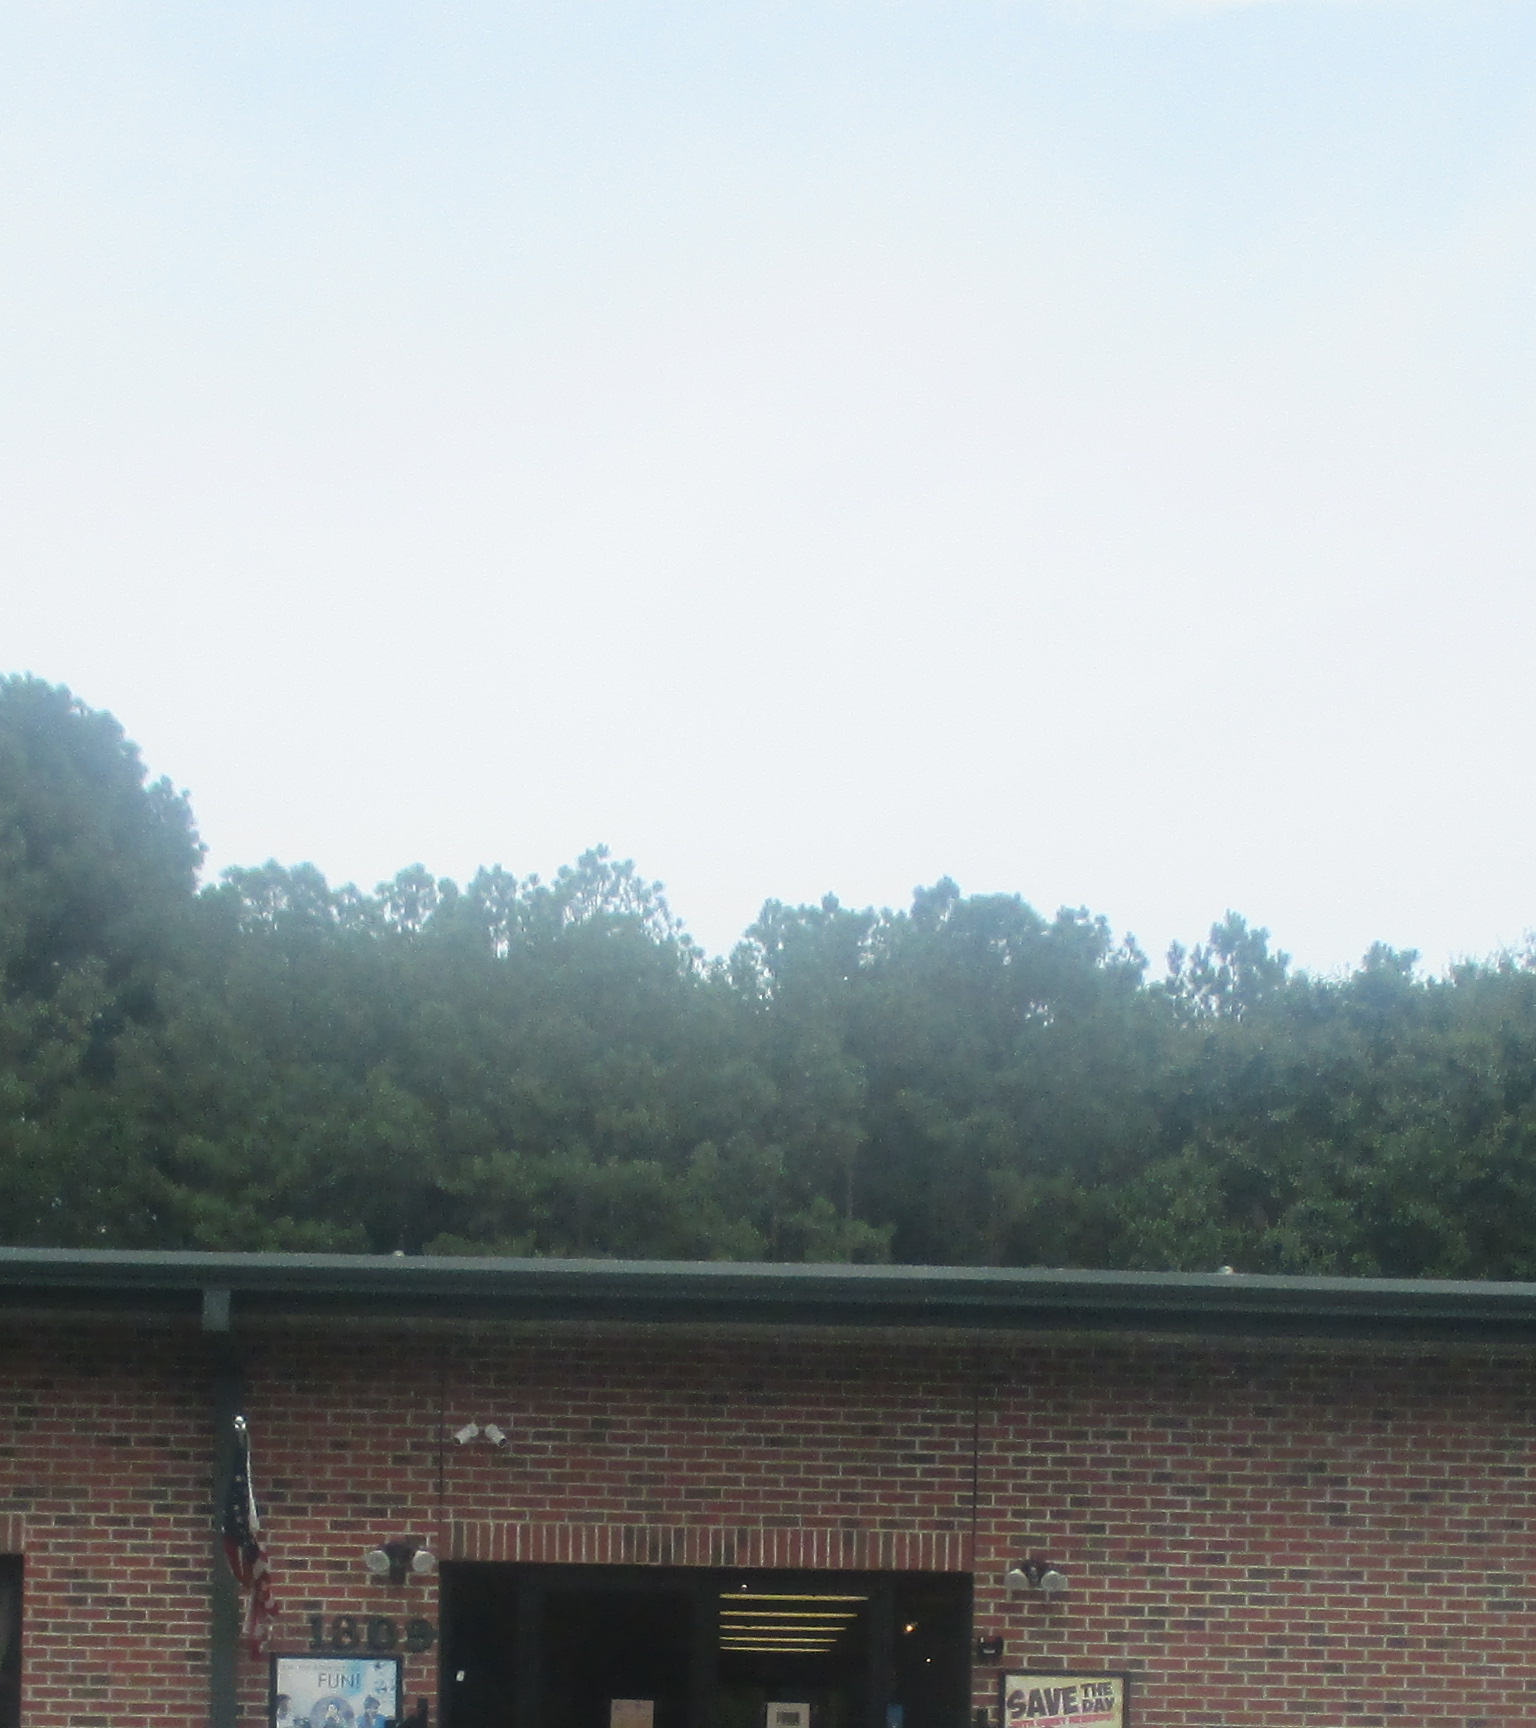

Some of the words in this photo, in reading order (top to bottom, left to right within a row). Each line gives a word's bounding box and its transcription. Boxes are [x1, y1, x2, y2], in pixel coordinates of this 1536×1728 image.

[318, 1672, 360, 1689] FUN!
[1080, 1681, 1113, 1698] THE
[1006, 1686, 1079, 1719] SAVE
[1081, 1697, 1115, 1713] DAY
